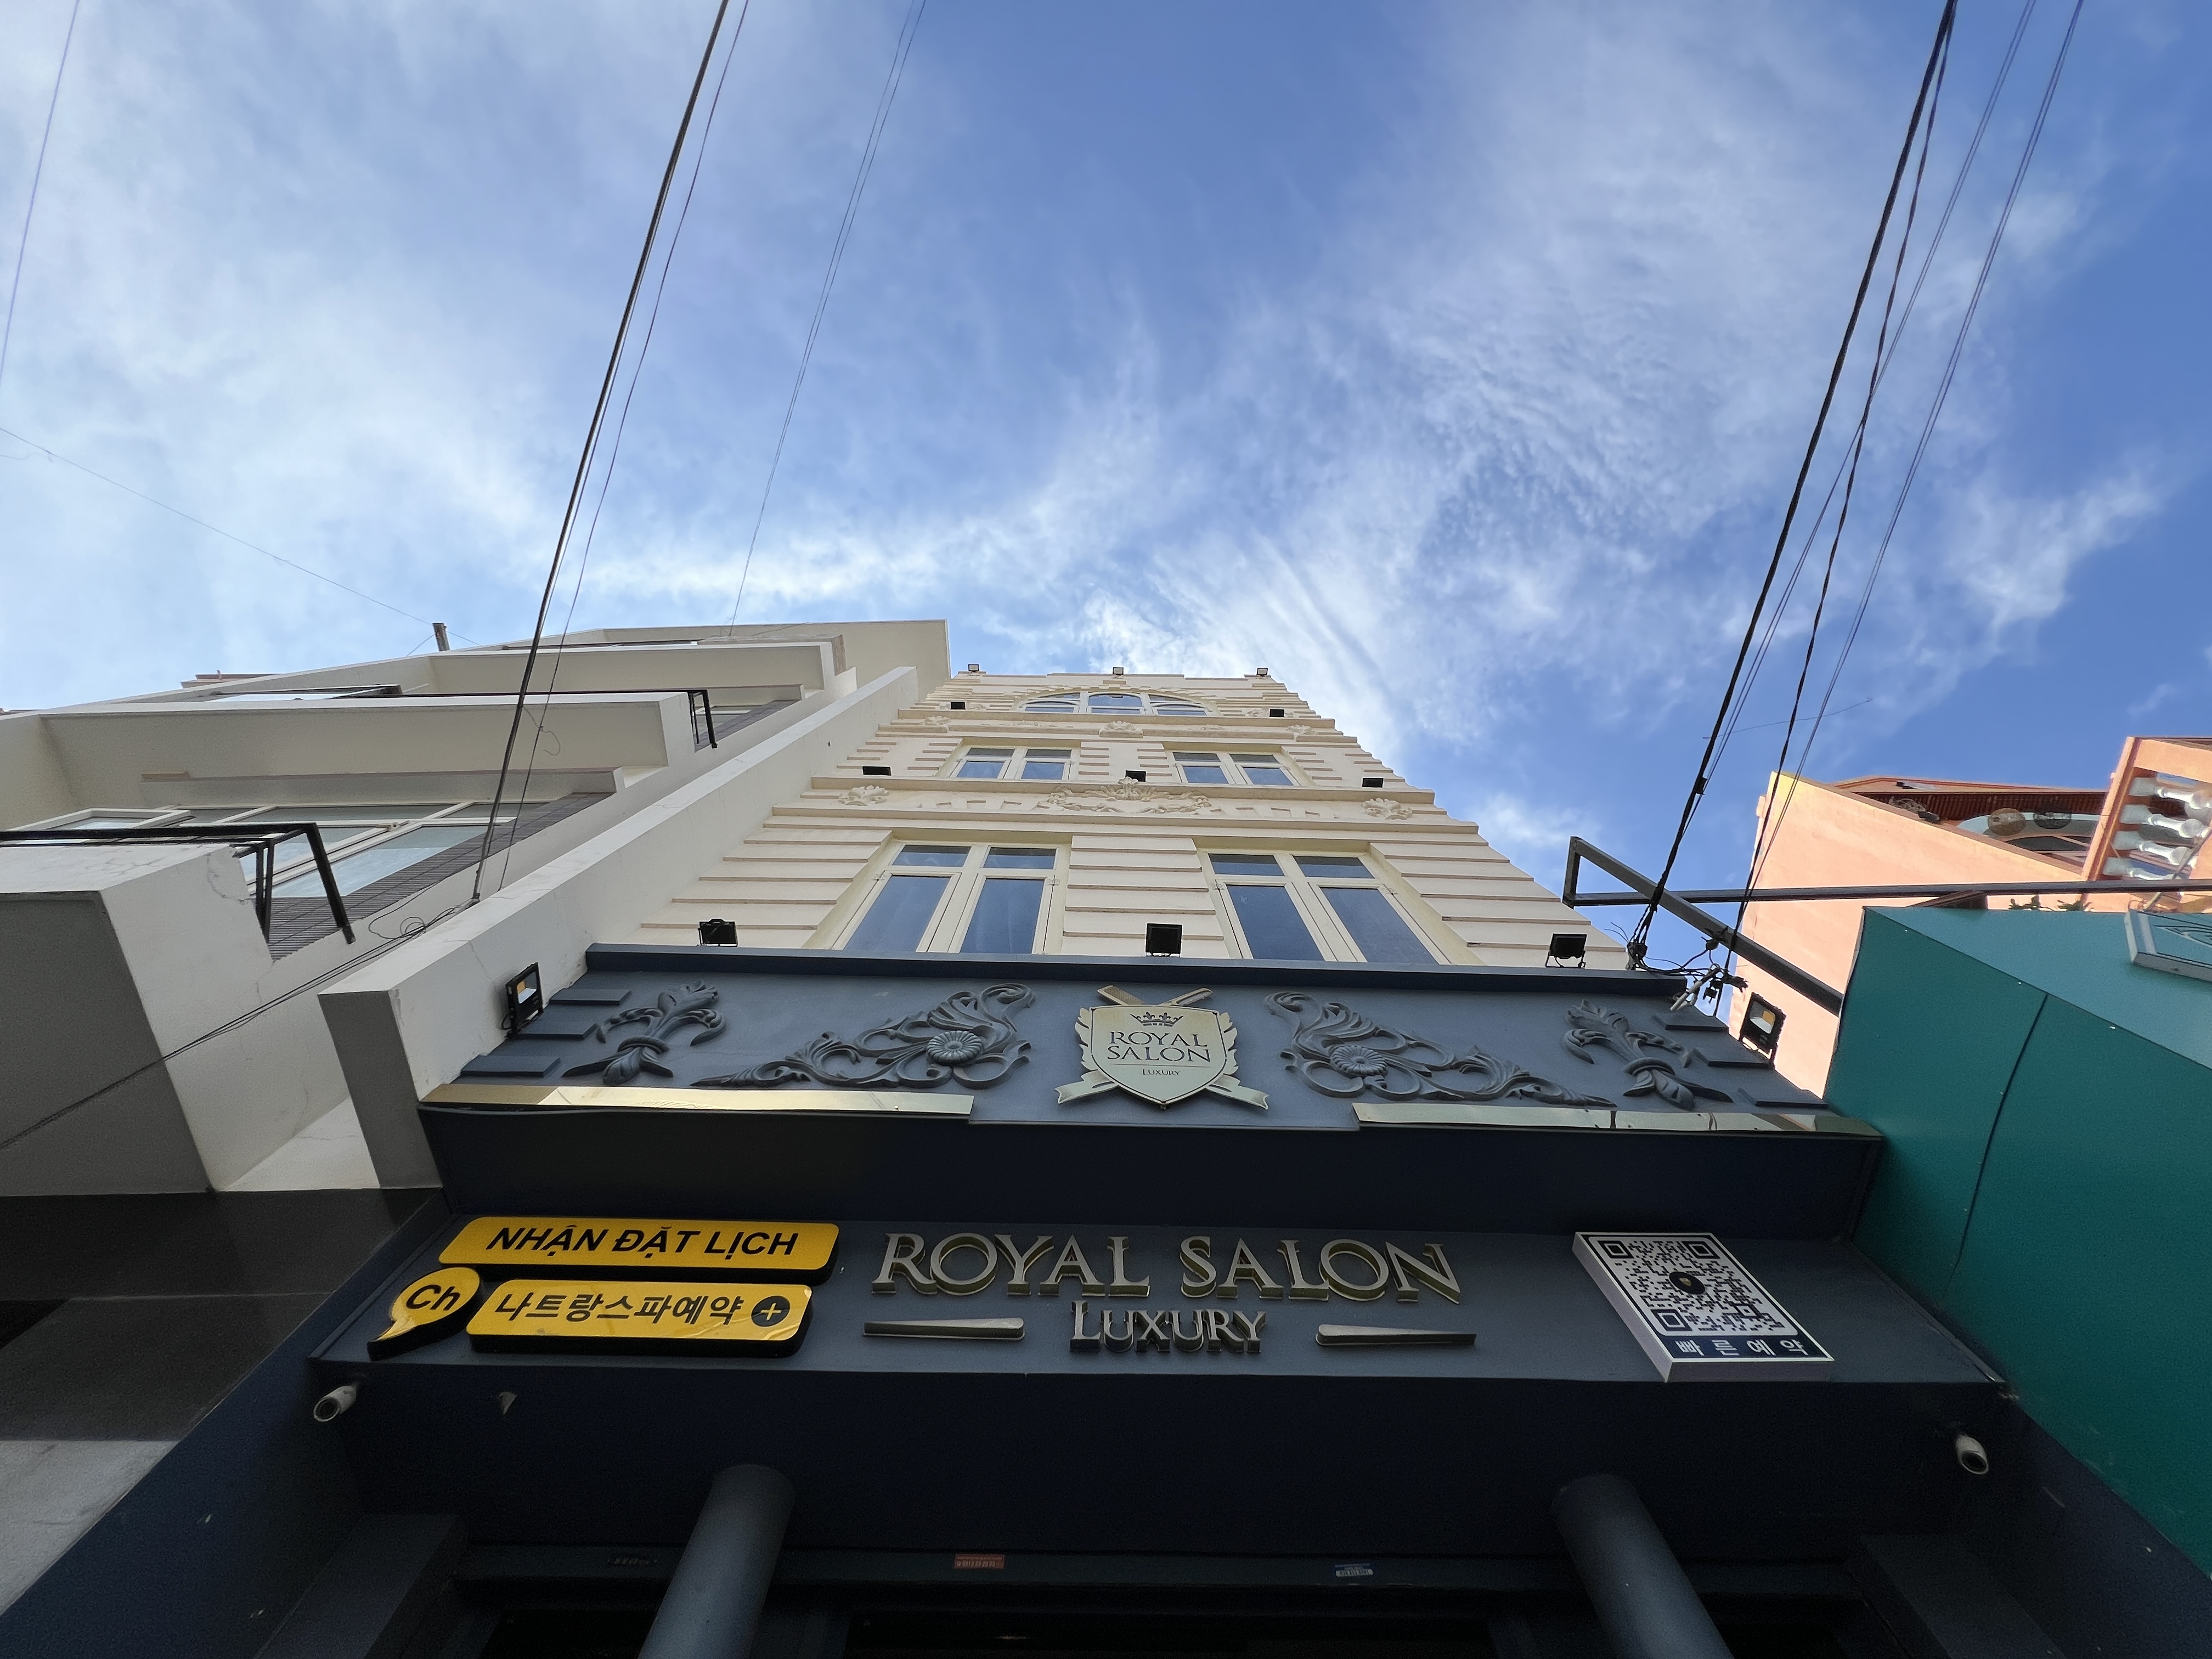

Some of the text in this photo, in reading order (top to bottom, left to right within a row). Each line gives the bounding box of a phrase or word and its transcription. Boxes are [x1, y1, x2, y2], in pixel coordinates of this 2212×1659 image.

[1109, 1031, 1209, 1047] ROYAL
[1107, 1046, 1211, 1063] SALON
[486, 1224, 799, 1260] NHẬN ĐẶT LỊCH
[872, 1232, 1461, 1304] ROYAL SALON
[405, 1284, 461, 1312] Ch
[493, 1292, 744, 1325] 나트랑스파예약
